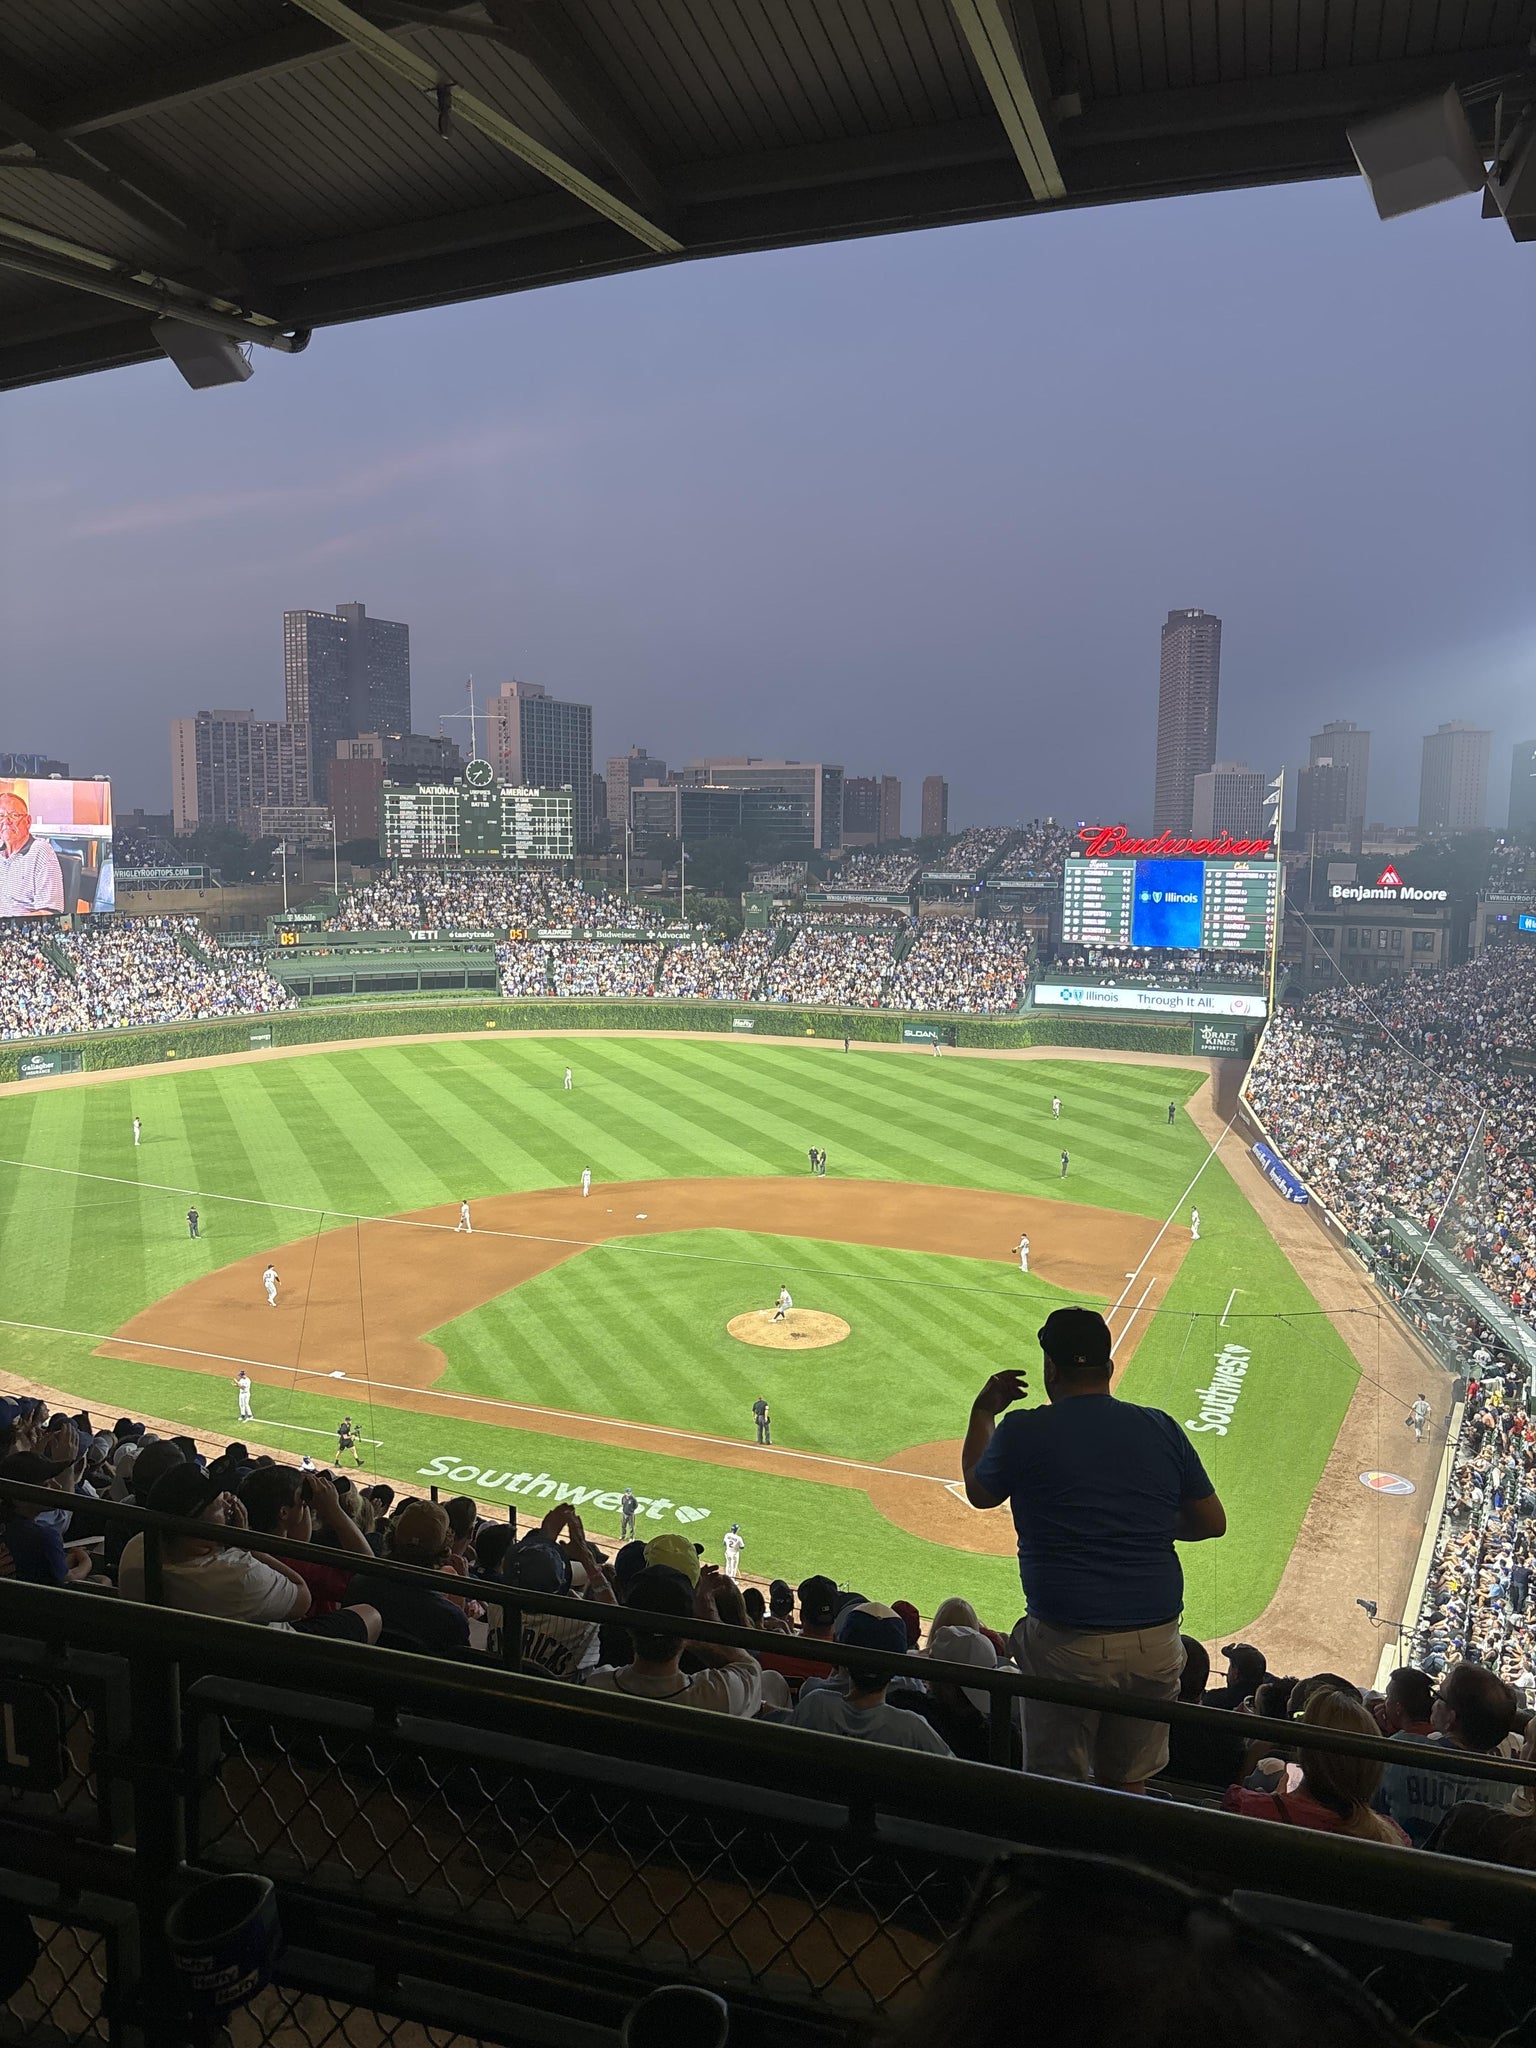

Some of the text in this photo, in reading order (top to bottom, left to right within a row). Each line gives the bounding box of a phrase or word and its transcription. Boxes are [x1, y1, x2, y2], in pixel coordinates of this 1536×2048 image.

[419, 787, 460, 795] NATIONAL
[500, 788, 540, 797] AMERICAN
[1078, 825, 1272, 857] Budweiser
[1165, 892, 1199, 904] Illinois
[1332, 885, 1448, 901] Benjamin Moore
[409, 931, 438, 940] YETI
[454, 931, 495, 939] tastytrade
[596, 930, 636, 939] Budweiser
[657, 931, 691, 939] Advocate
[1086, 991, 1118, 1003] Illinois
[1137, 994, 1184, 1009] Through
[1187, 996, 1195, 1007] It
[1202, 1030, 1238, 1040] DRAFT
[21, 1062, 54, 1072] Gallagher
[1184, 1353, 1251, 1436] Southwest
